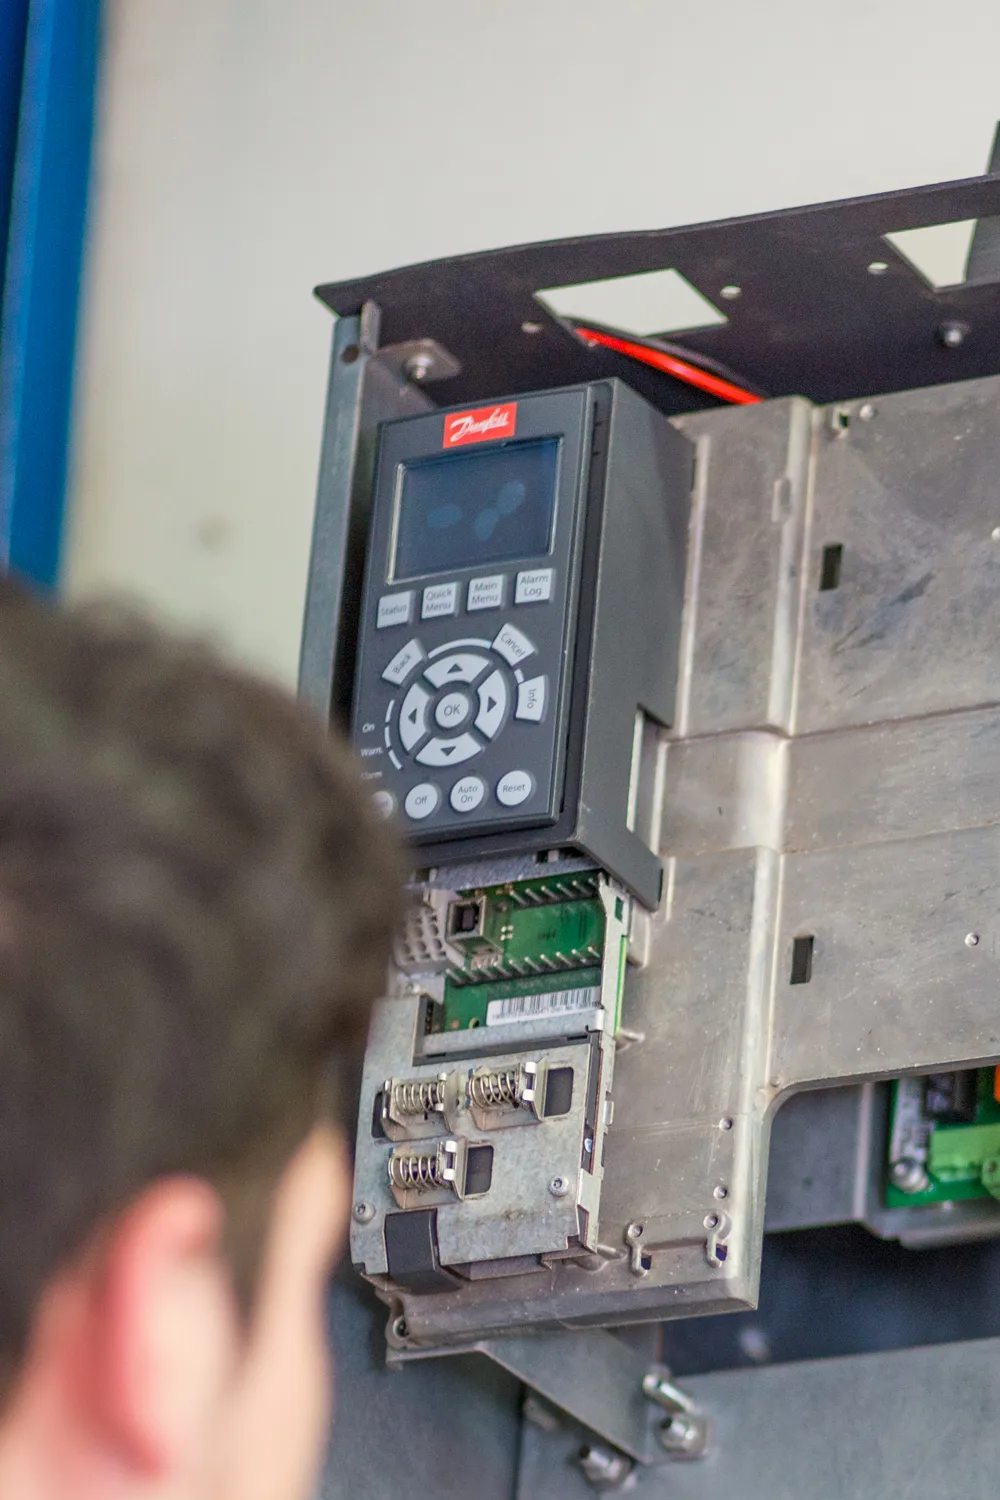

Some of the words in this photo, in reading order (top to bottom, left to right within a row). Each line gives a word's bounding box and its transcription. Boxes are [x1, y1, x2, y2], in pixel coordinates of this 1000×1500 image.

[520, 573, 548, 585] Alarm
[474, 582, 498, 592] Main
[524, 586, 542, 598] Log
[426, 588, 452, 601] Quick
[471, 594, 498, 605] Menu
[380, 604, 407, 616] Status
[425, 602, 452, 613] Menu
[501, 633, 526, 657] Cancel
[527, 688, 537, 710] Info
[443, 705, 461, 717] OK
[362, 723, 376, 734] On
[458, 785, 478, 794] Auto
[502, 784, 526, 794] Reset
[415, 795, 428, 806] Off
[460, 795, 474, 805] On
